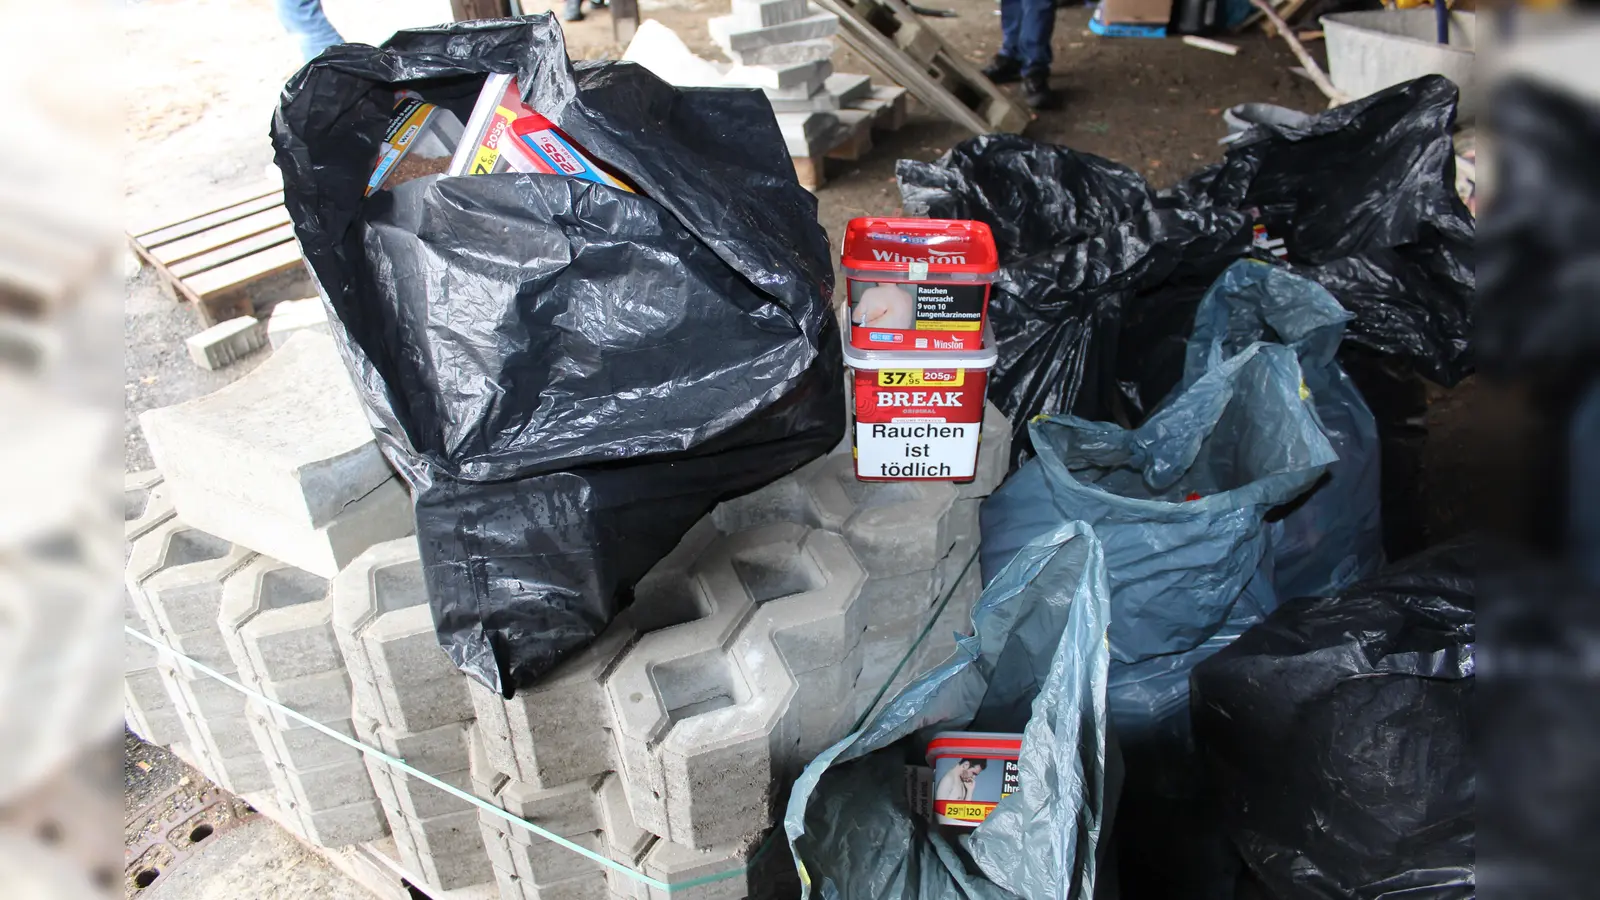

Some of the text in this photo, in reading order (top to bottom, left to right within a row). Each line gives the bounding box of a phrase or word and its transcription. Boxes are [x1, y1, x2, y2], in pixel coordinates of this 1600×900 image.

[399, 125, 418, 144] West
[872, 248, 966, 265] Winston
[917, 311, 981, 319] Lungenkarzinomen
[933, 337, 964, 350] Winston
[924, 372, 951, 381] 205g
[876, 391, 963, 407] BREAK
[872, 424, 964, 438] Rauchen
[905, 443, 930, 457] ist
[881, 462, 951, 476] tödlich
[1006, 761, 1019, 771] Ra
[966, 807, 982, 816] 120
